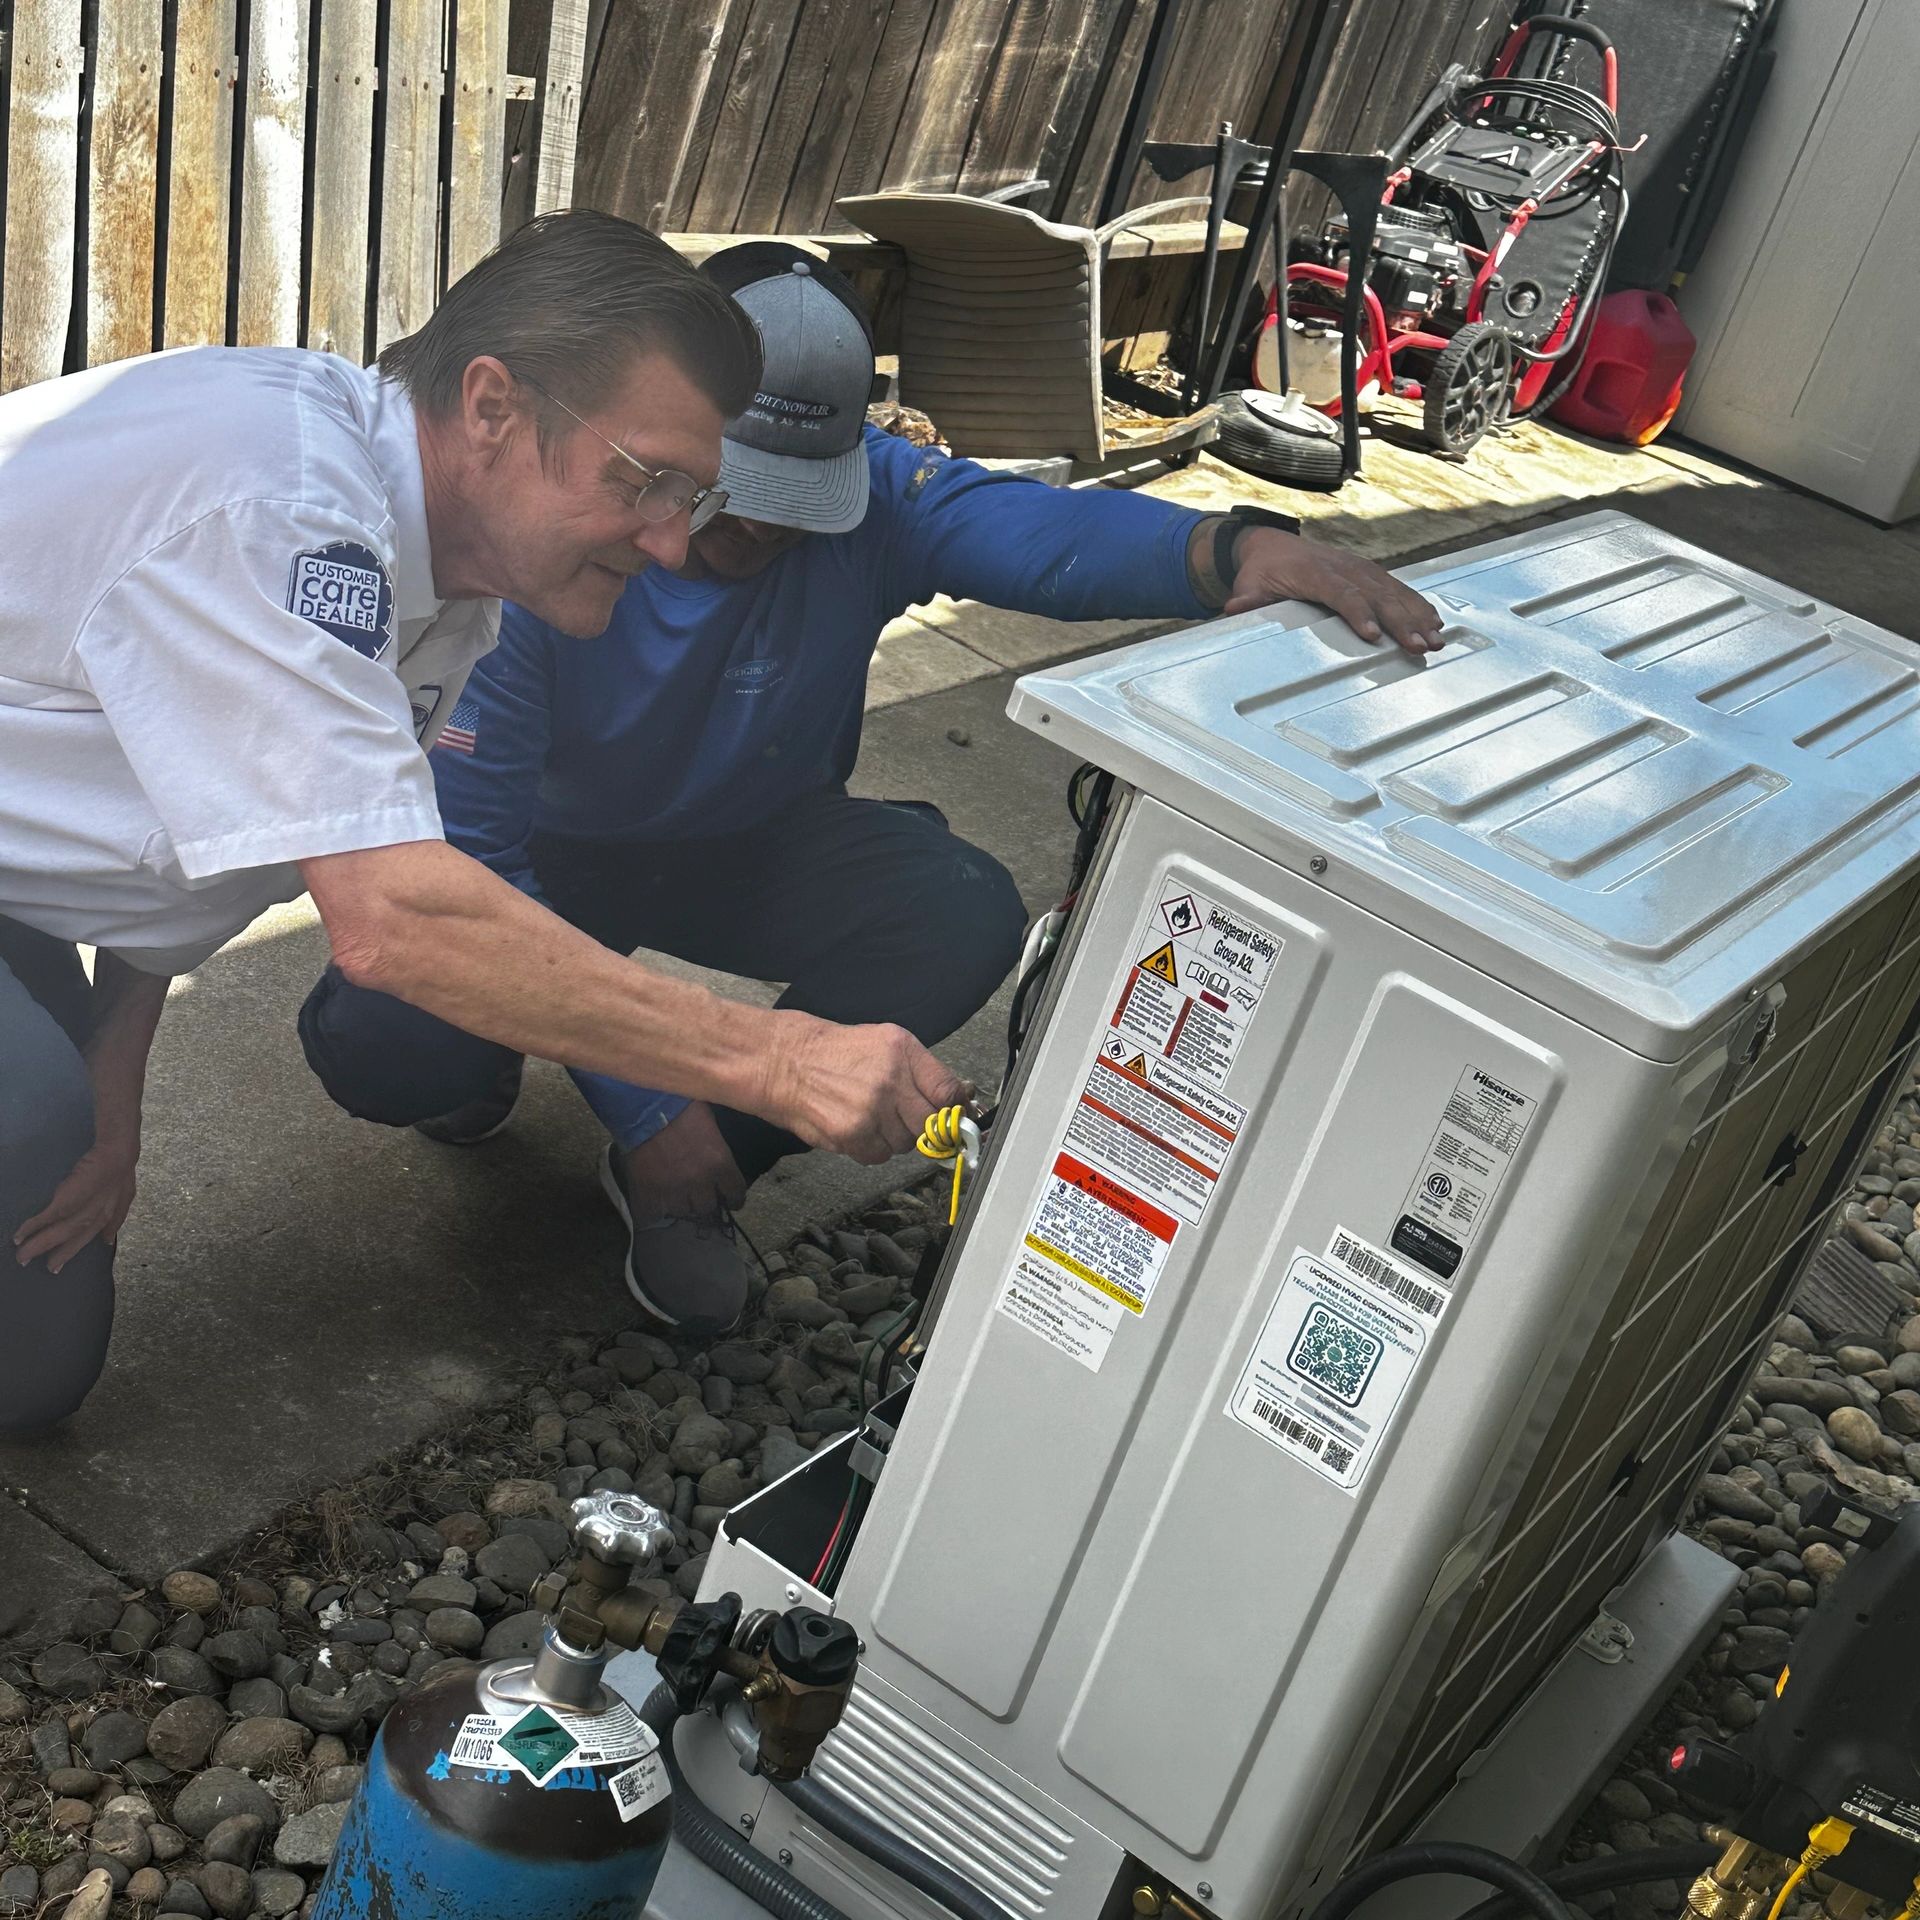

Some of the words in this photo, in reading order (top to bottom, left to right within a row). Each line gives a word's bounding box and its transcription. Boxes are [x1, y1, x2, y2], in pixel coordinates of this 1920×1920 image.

[754, 392, 781, 408] GHT
[781, 400, 809, 414] NOW
[808, 404, 830, 416] AIR
[305, 561, 378, 587] CUSTOMER
[301, 576, 376, 610] care
[300, 600, 374, 629] DEALER
[1208, 909, 1253, 949] Refrigerant
[1250, 932, 1276, 962] Safety
[1213, 940, 1239, 966] Group
[1238, 954, 1254, 974] A2L
[1153, 1069, 1187, 1097] Refrigerant
[1473, 1071, 1525, 1105] Hisense
[454, 1737, 494, 1760] UN1066
[536, 1762, 544, 1772] 2
